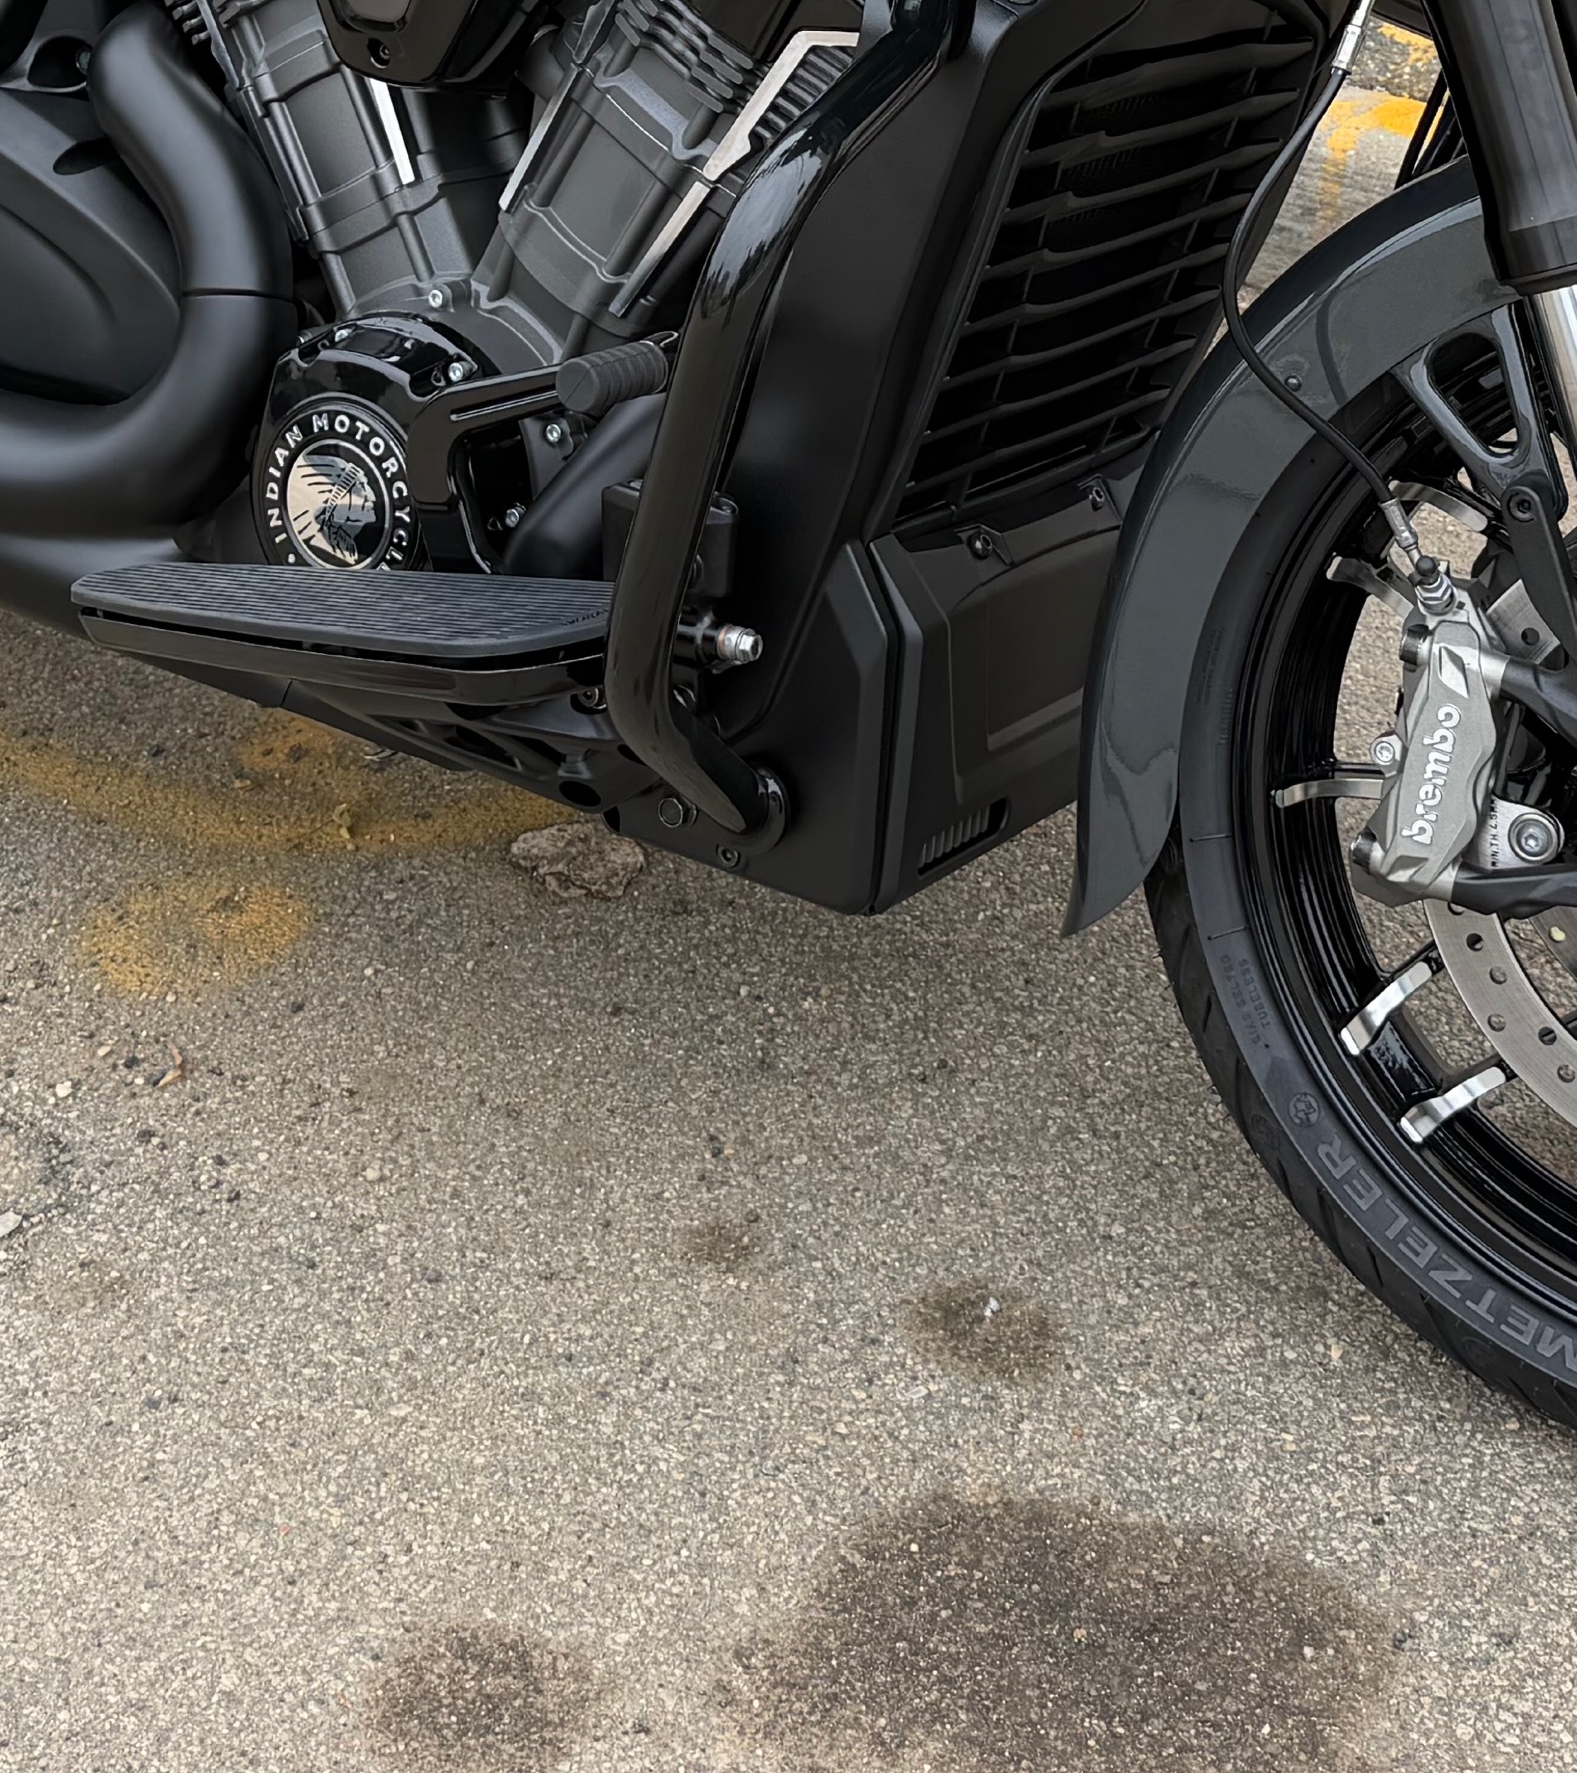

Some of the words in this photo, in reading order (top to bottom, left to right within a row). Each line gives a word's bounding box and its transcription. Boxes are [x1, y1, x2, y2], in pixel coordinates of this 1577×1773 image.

[266, 425, 303, 543] INDIAN
[1401, 703, 1462, 846] brembo
[1238, 958, 1272, 1030] TUBELESS
